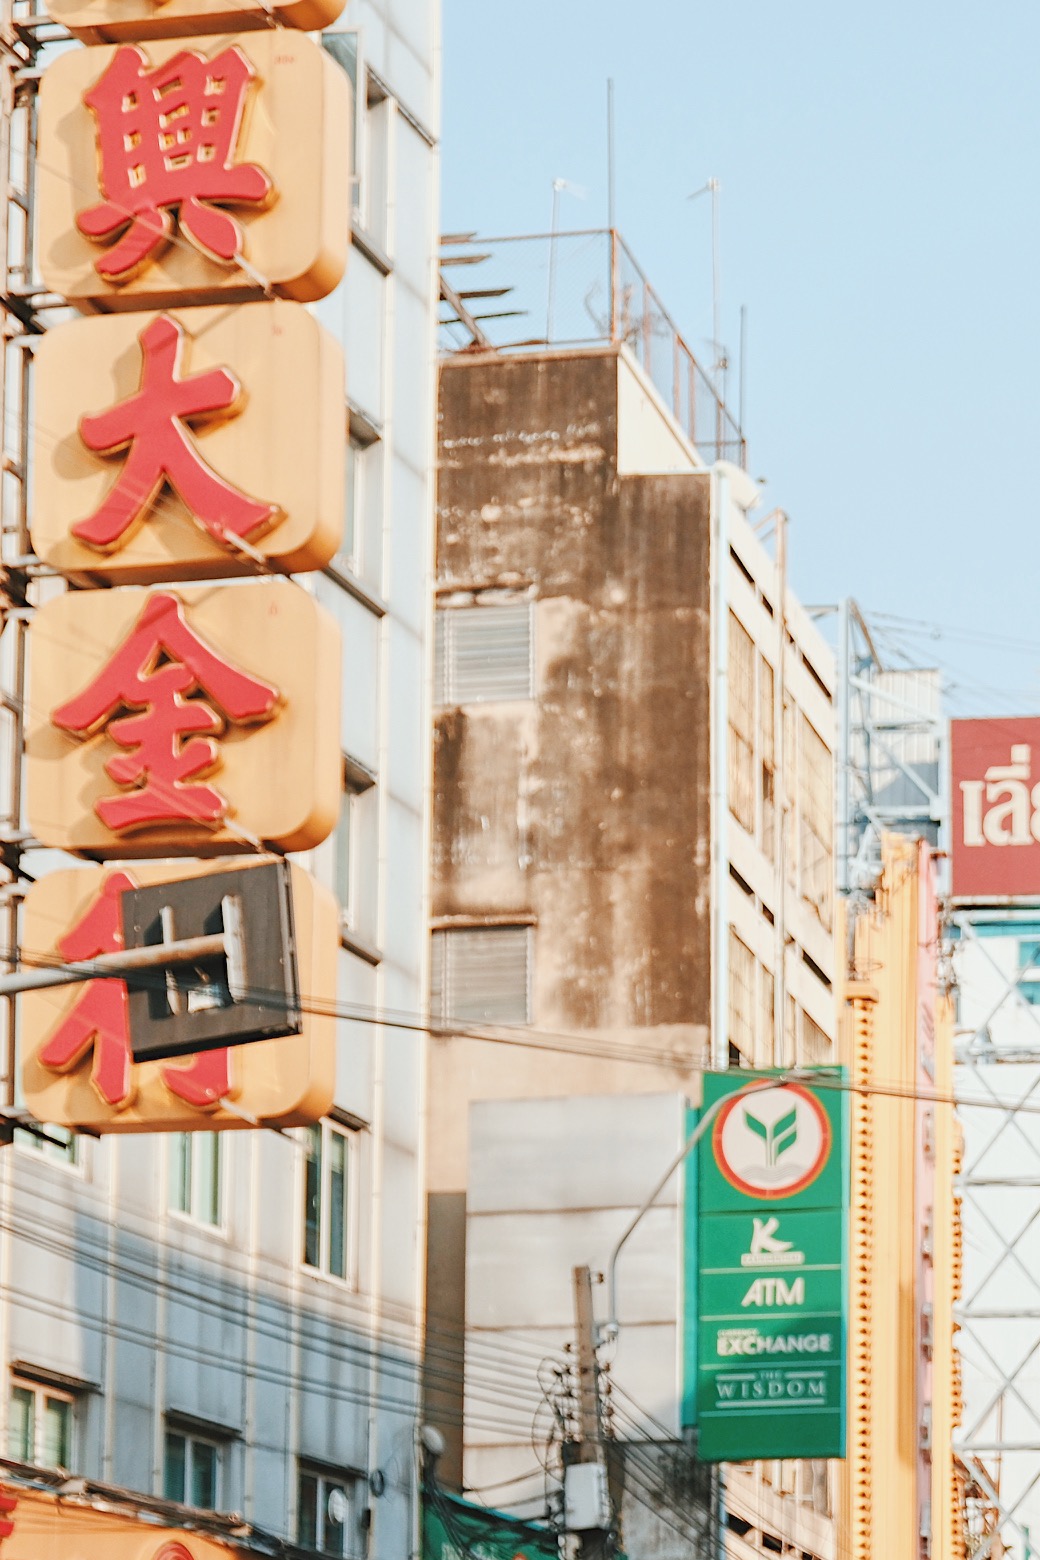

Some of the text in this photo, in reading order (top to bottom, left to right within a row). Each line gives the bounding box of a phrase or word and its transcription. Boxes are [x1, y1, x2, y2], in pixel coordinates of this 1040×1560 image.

[749, 1217, 794, 1253] K
[741, 1277, 805, 1307] ATM
[717, 1334, 832, 1356] EXCHANGE
[716, 1380, 827, 1398] WISDOM
